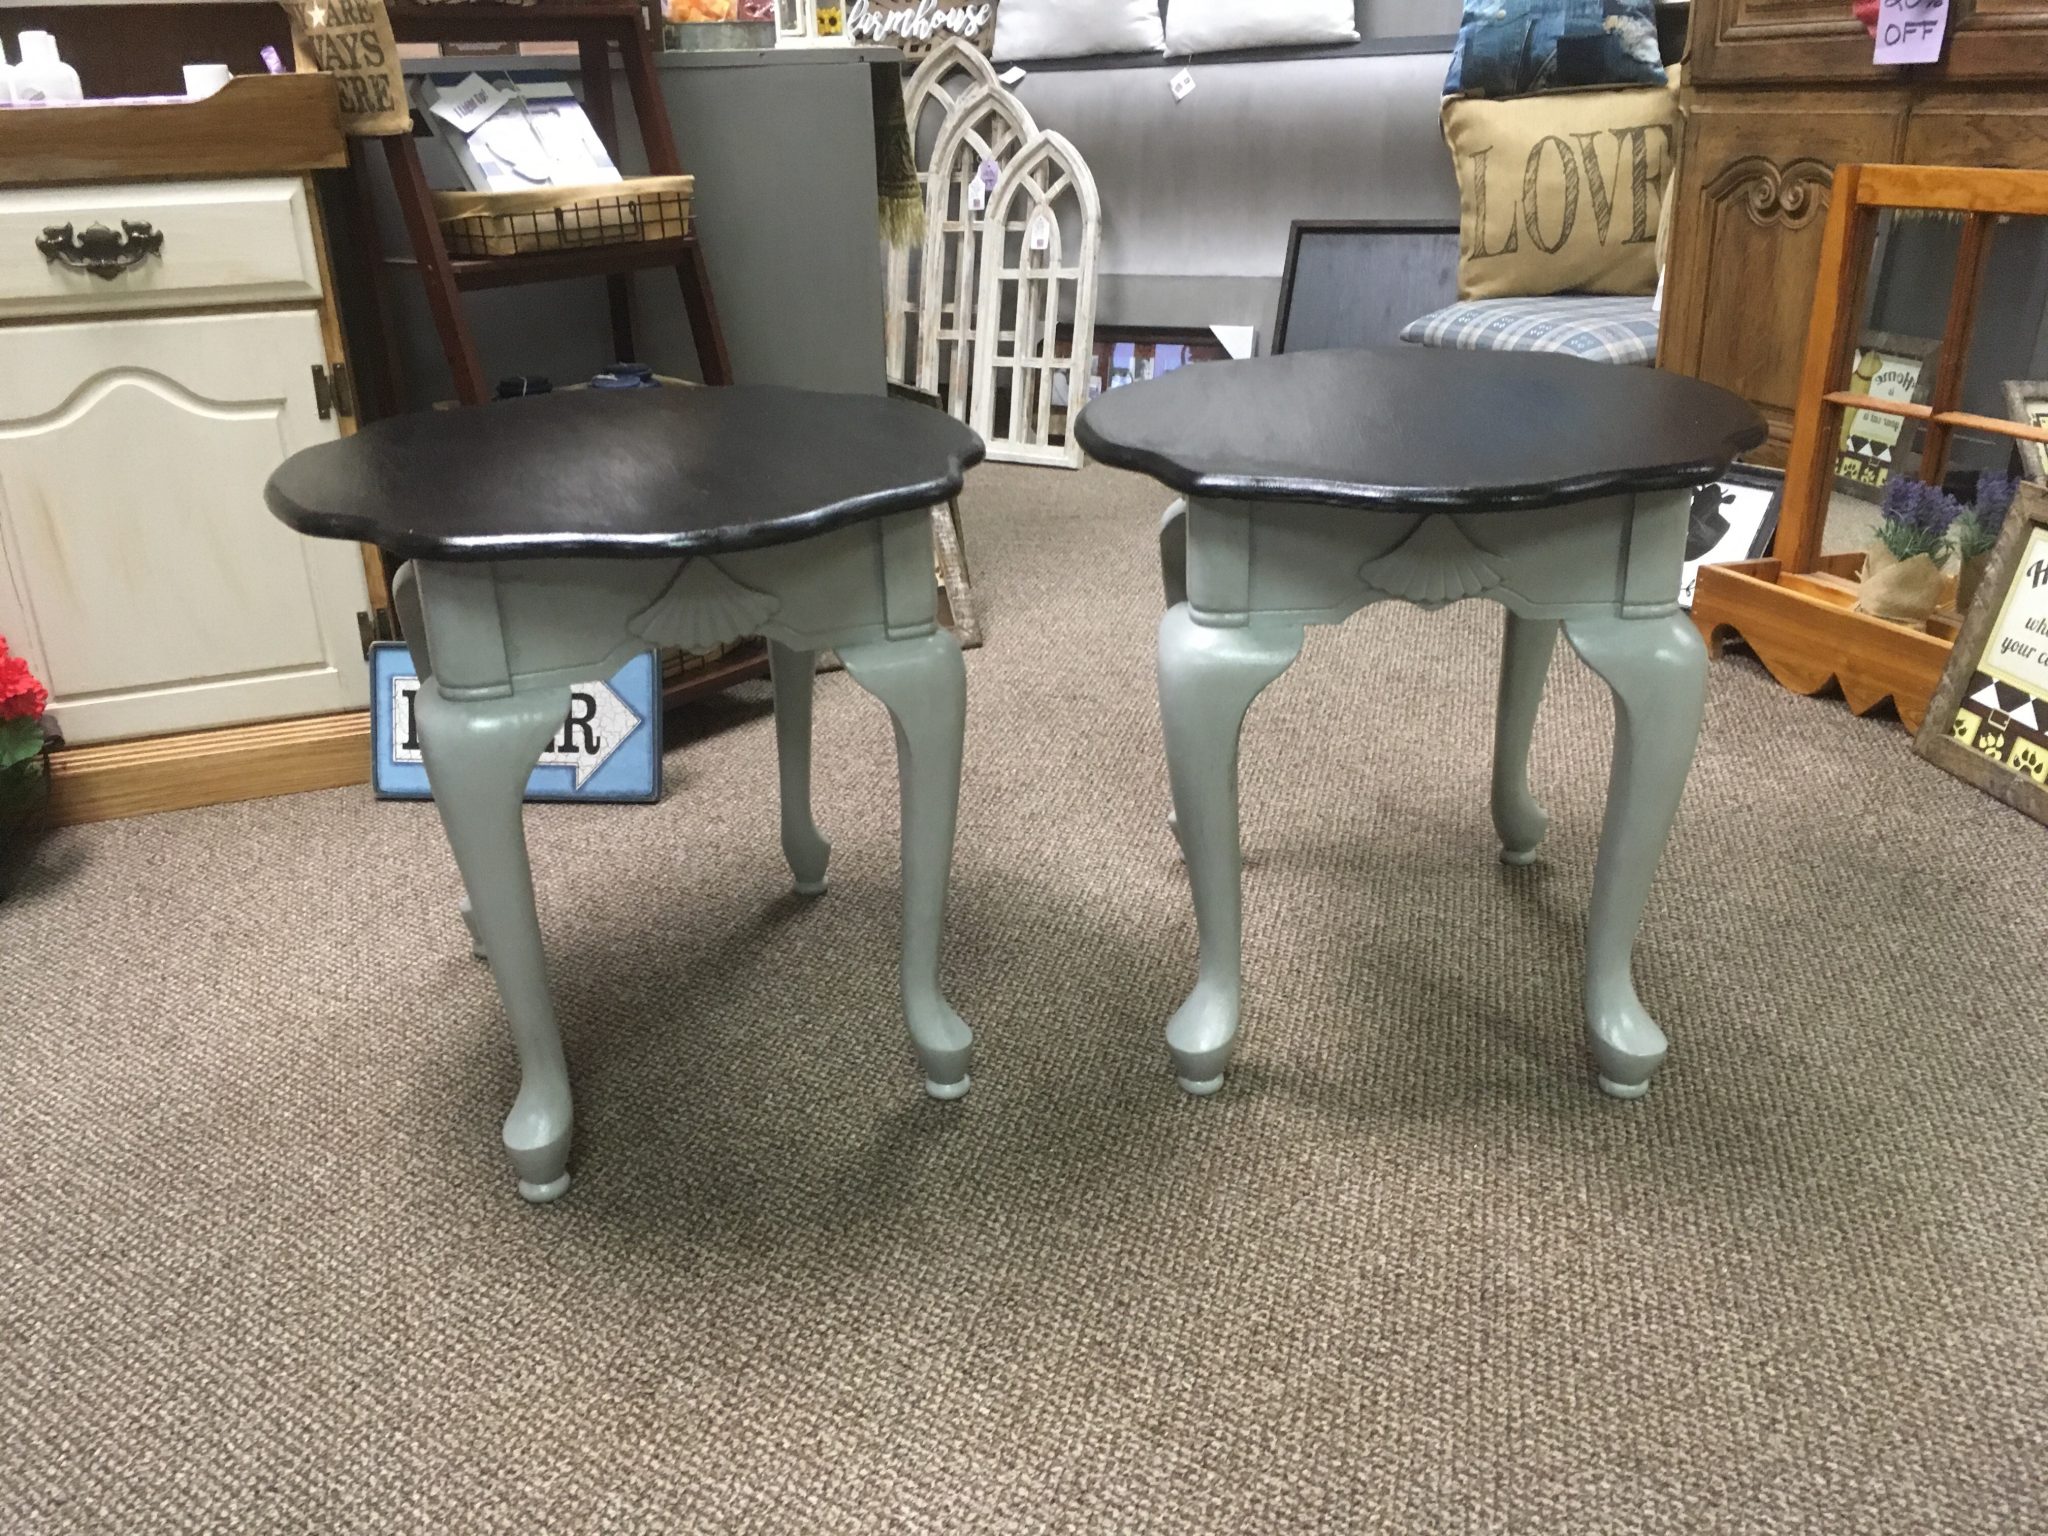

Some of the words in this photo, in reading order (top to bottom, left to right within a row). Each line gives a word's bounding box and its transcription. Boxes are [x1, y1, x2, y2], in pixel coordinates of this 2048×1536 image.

[326, 0, 375, 28] ARE
[1884, 20, 1939, 46] OFF
[337, 73, 395, 113] ERE
[1468, 124, 1673, 261] LOVE
[2025, 617, 2048, 637] wh
[2000, 637, 2037, 659] your
